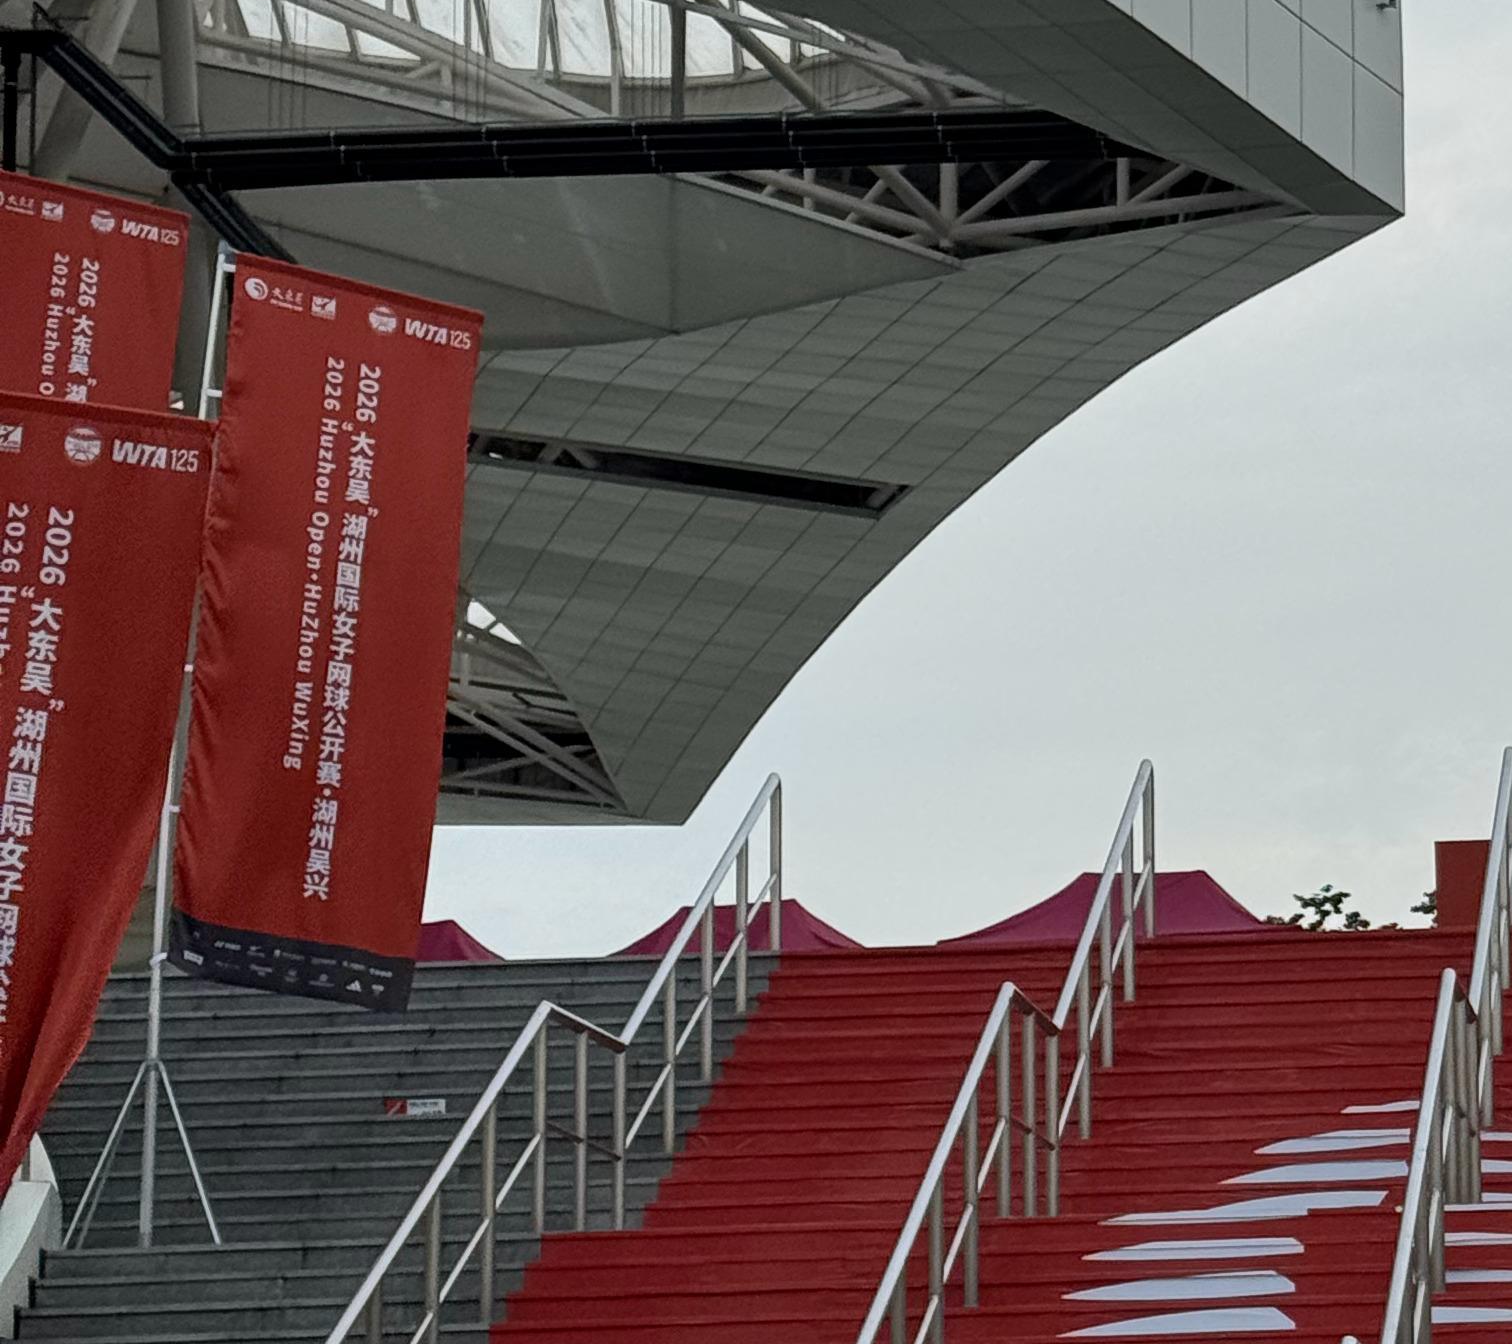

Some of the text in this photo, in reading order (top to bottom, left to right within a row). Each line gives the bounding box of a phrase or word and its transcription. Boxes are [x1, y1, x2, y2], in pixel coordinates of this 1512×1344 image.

[51, 252, 70, 298] 2026
[41, 303, 64, 375] Huzhou
[323, 356, 345, 411] 2026
[314, 418, 339, 504] Huzhou
[0, 502, 29, 574] 2026
[283, 682, 314, 770] WuXing
